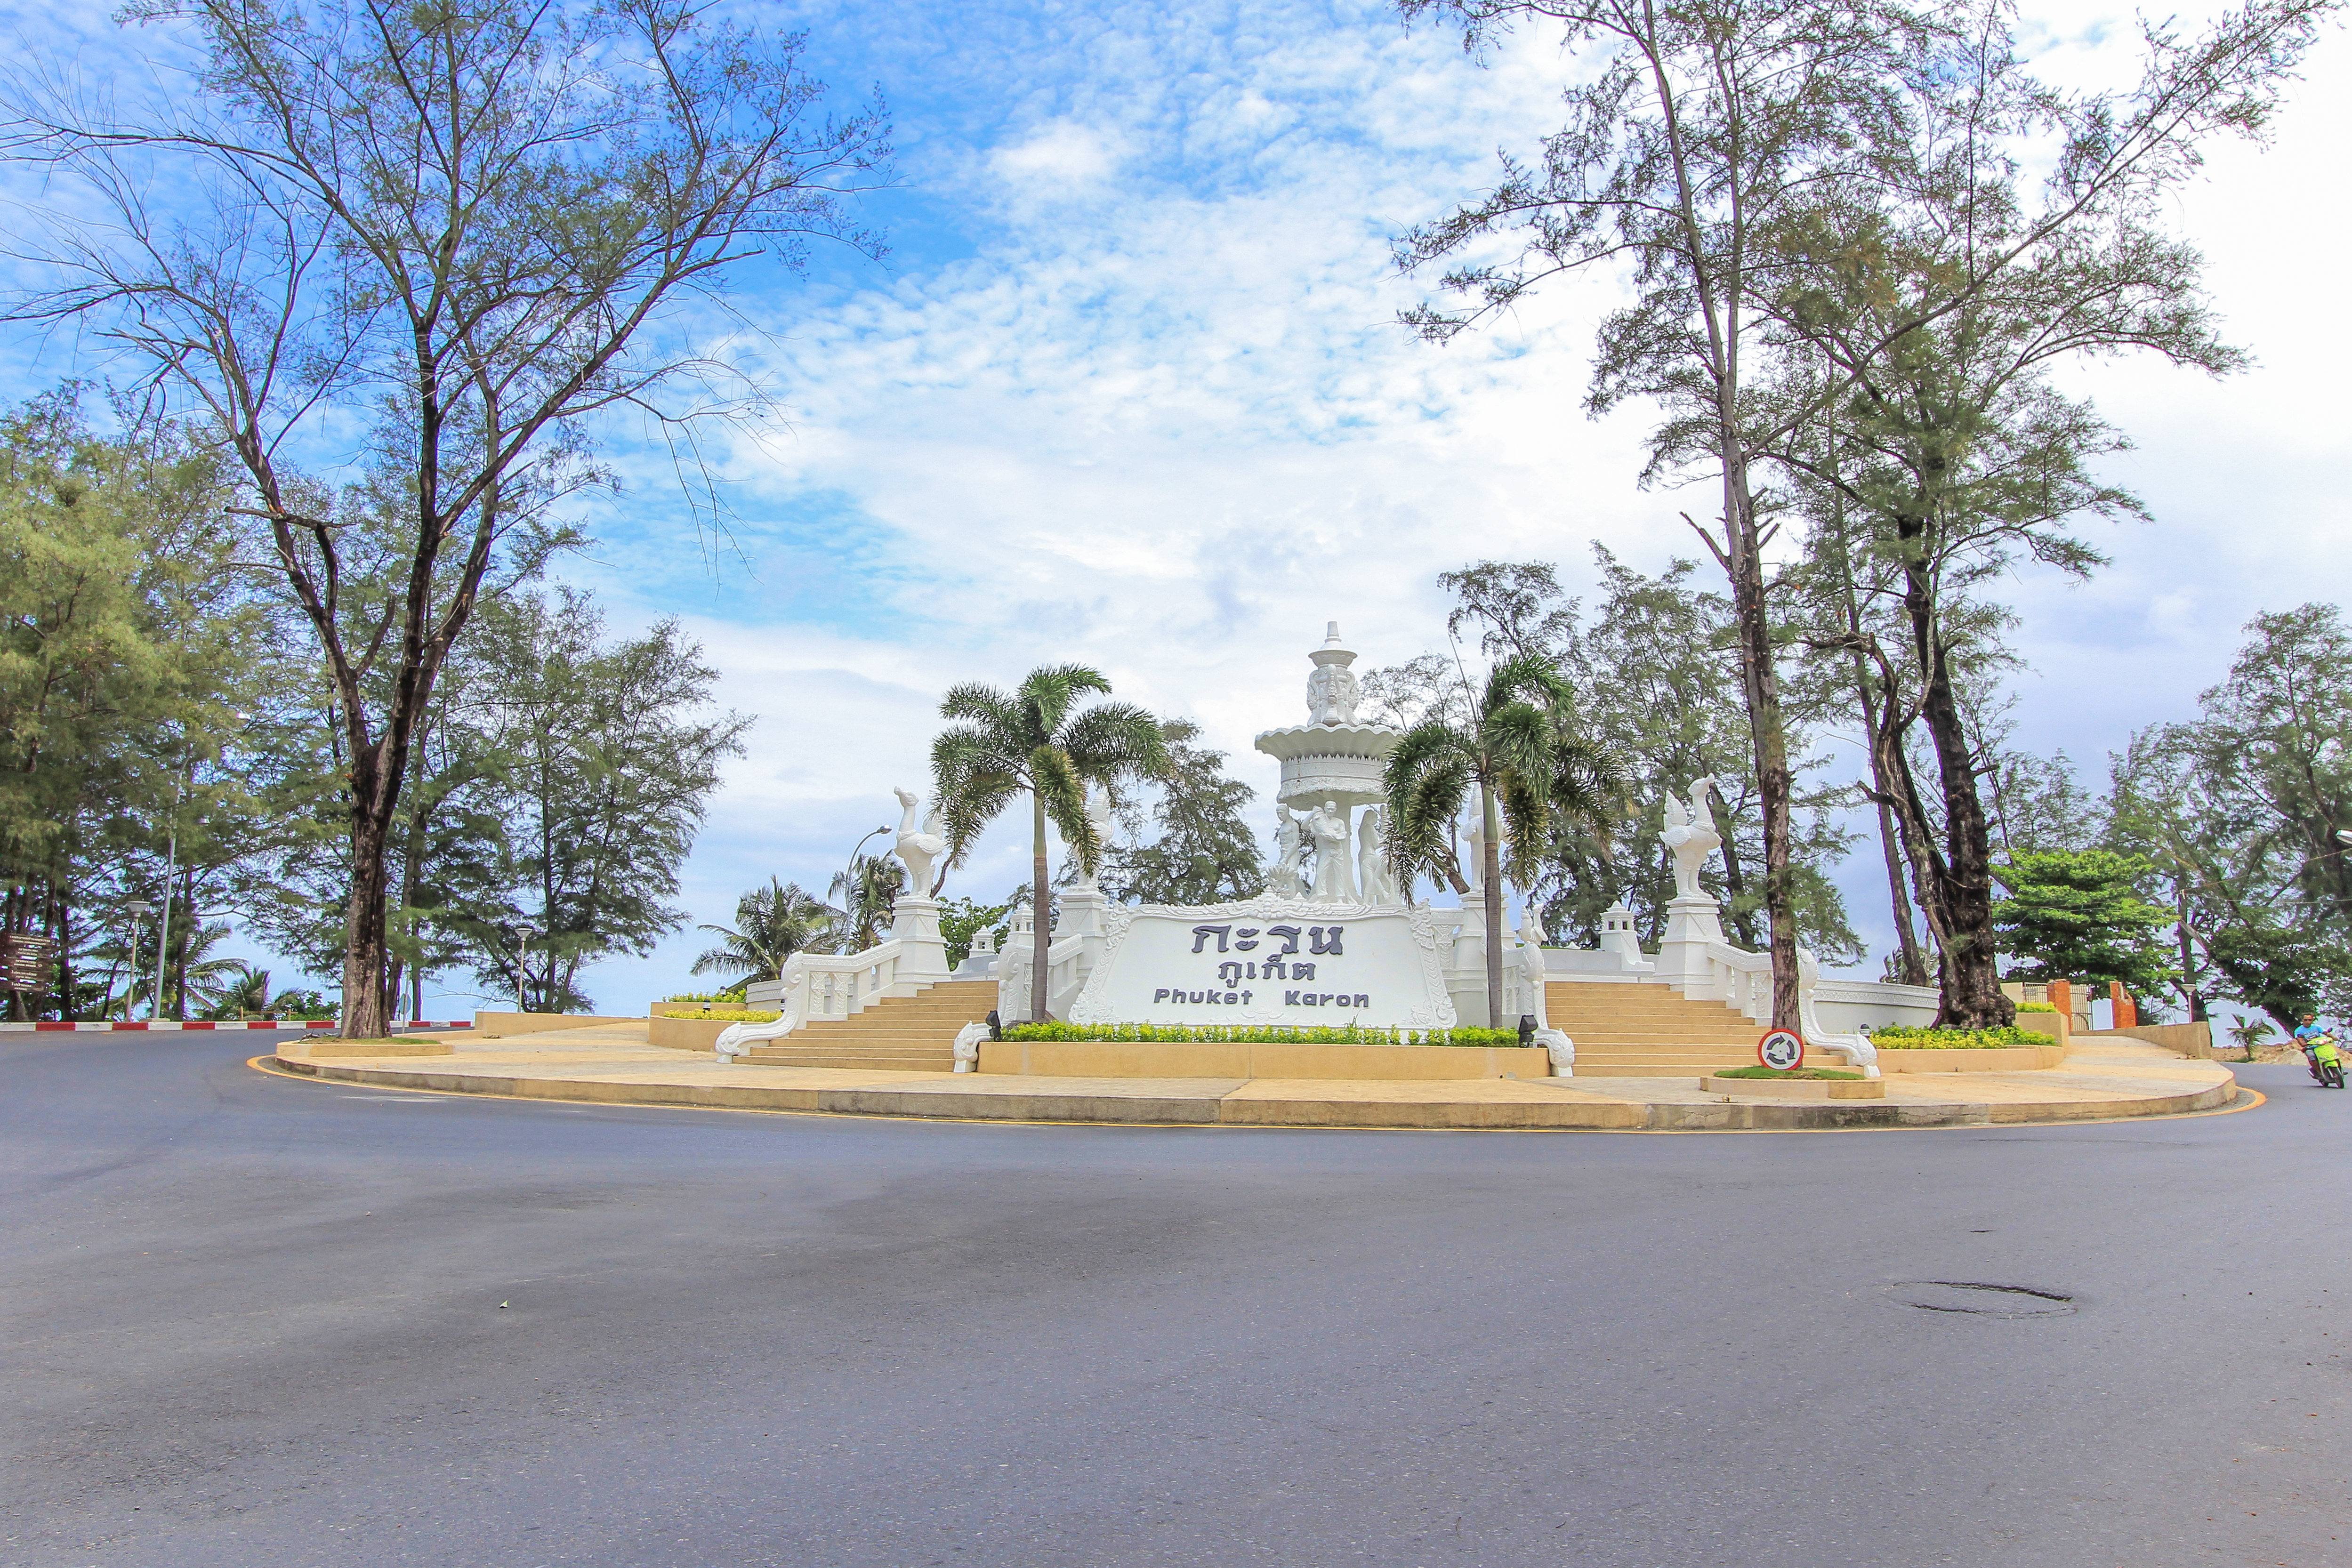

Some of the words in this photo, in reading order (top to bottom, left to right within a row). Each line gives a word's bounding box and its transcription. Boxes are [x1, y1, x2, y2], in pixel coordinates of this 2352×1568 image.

[1191, 924, 1343, 955] กะรน
[1218, 952, 1317, 988] ภูเก็ต
[1153, 988, 1253, 1005] Phuket
[1285, 990, 1369, 1007] Karon
